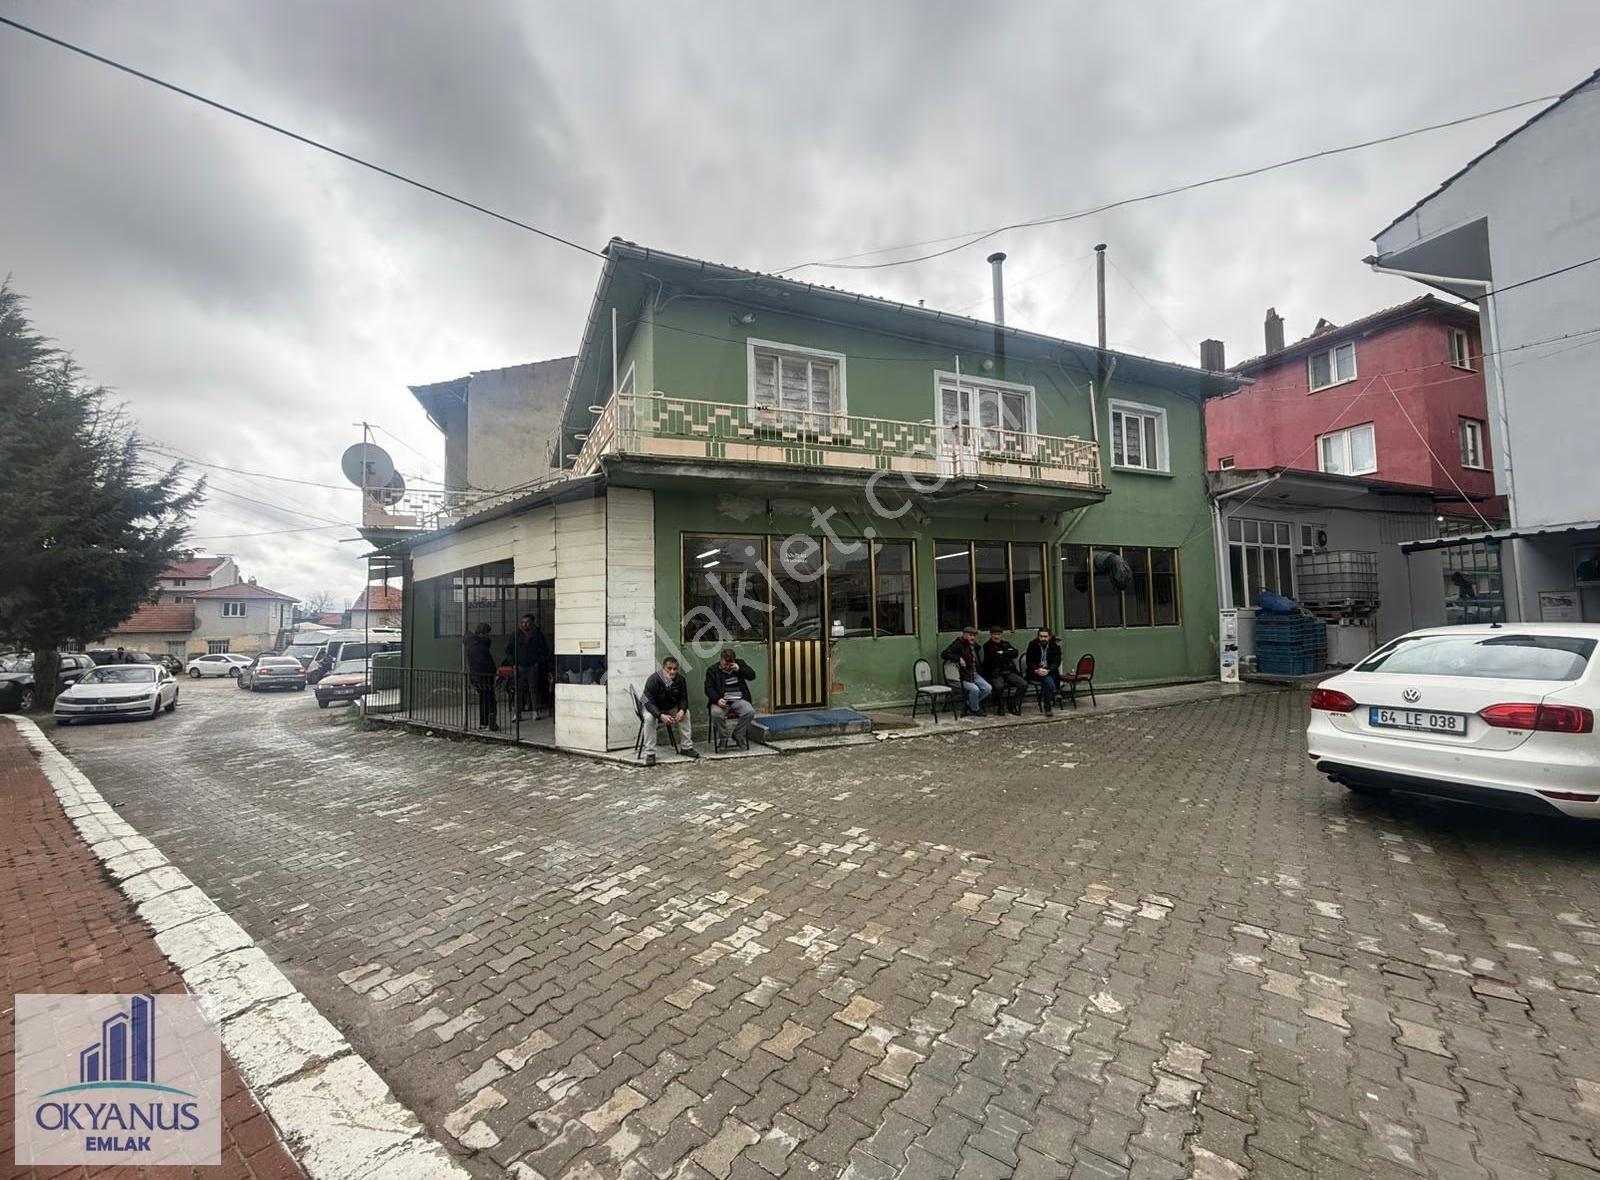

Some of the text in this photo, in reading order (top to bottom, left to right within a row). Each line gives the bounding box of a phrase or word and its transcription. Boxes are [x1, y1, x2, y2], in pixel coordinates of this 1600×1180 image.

[1380, 710, 1396, 723] 64
[1405, 712, 1423, 726] LE
[1429, 714, 1456, 729] 038
